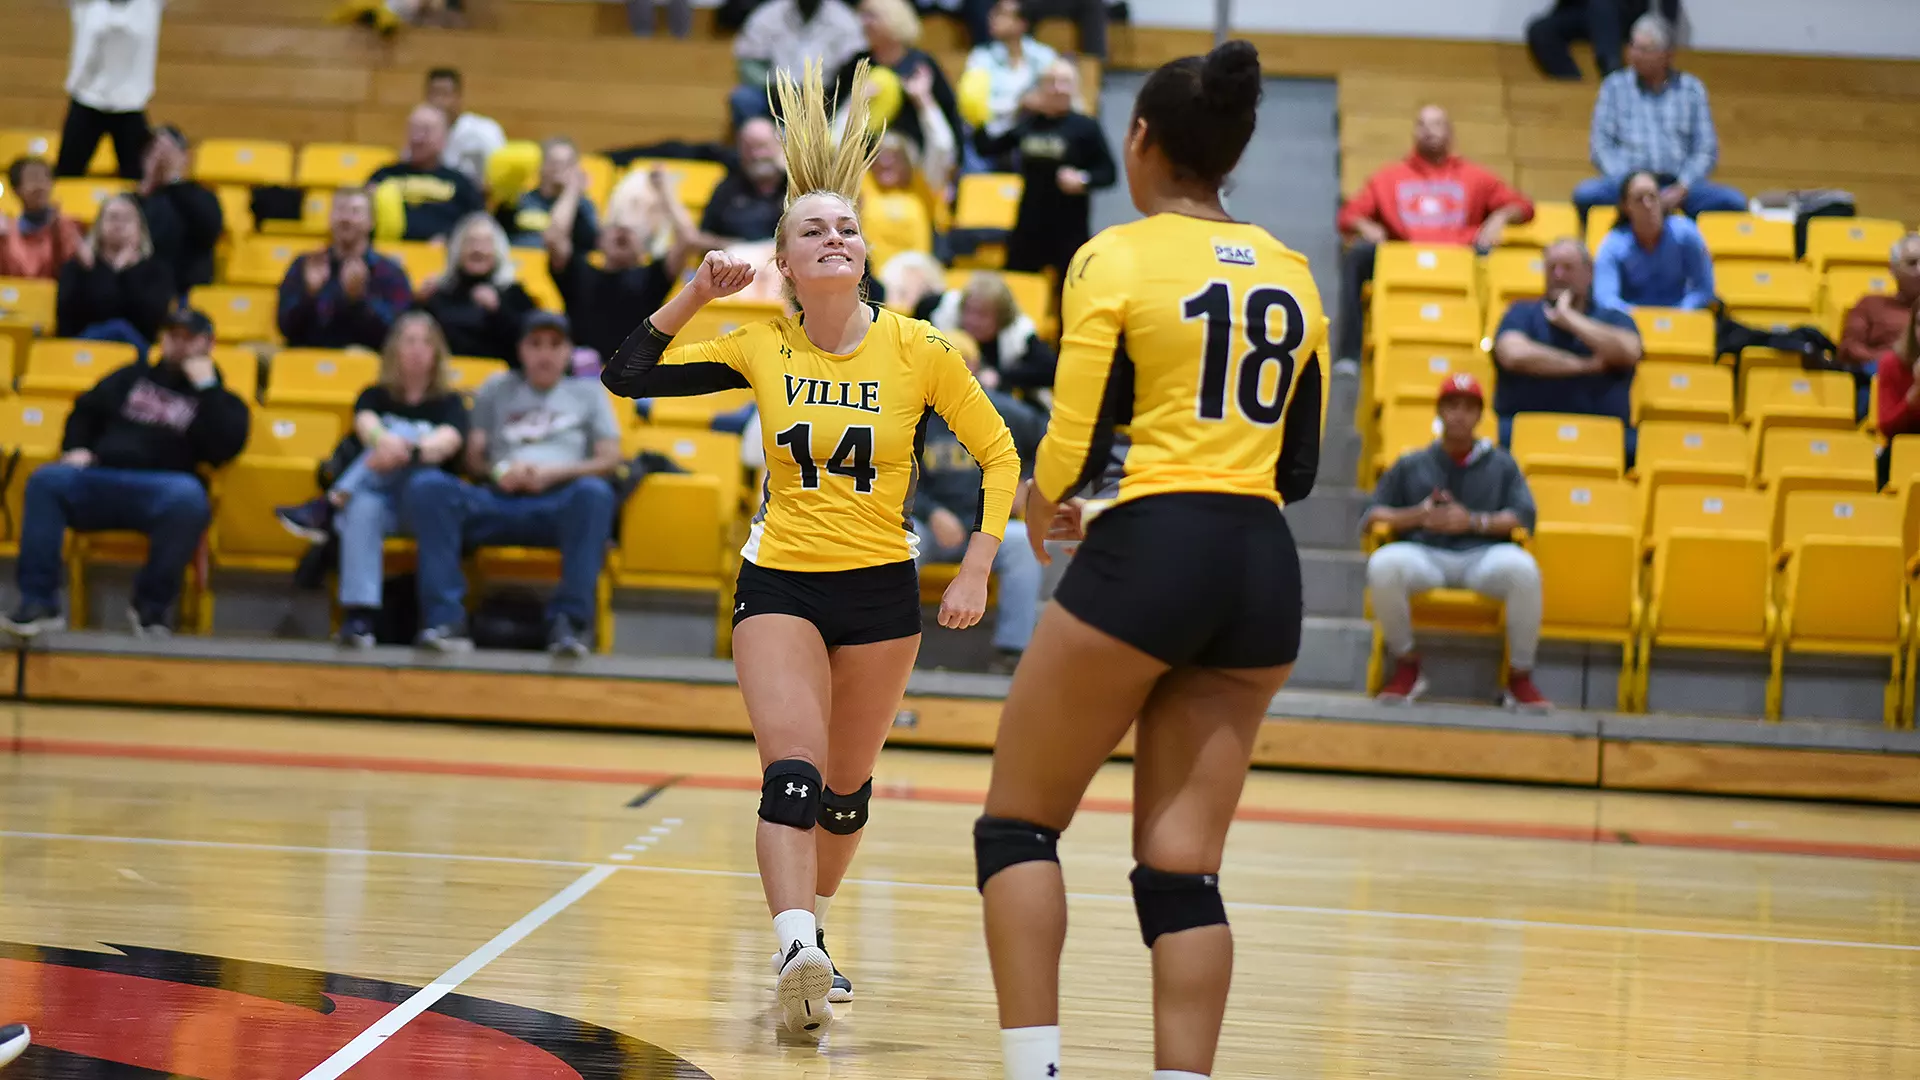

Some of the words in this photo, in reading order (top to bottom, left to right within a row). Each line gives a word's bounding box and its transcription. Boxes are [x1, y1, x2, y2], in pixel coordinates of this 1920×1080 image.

[1214, 245, 1254, 263] PSAC
[1180, 280, 1305, 425] 18
[783, 373, 881, 413] VILLE
[776, 422, 877, 493] 14
